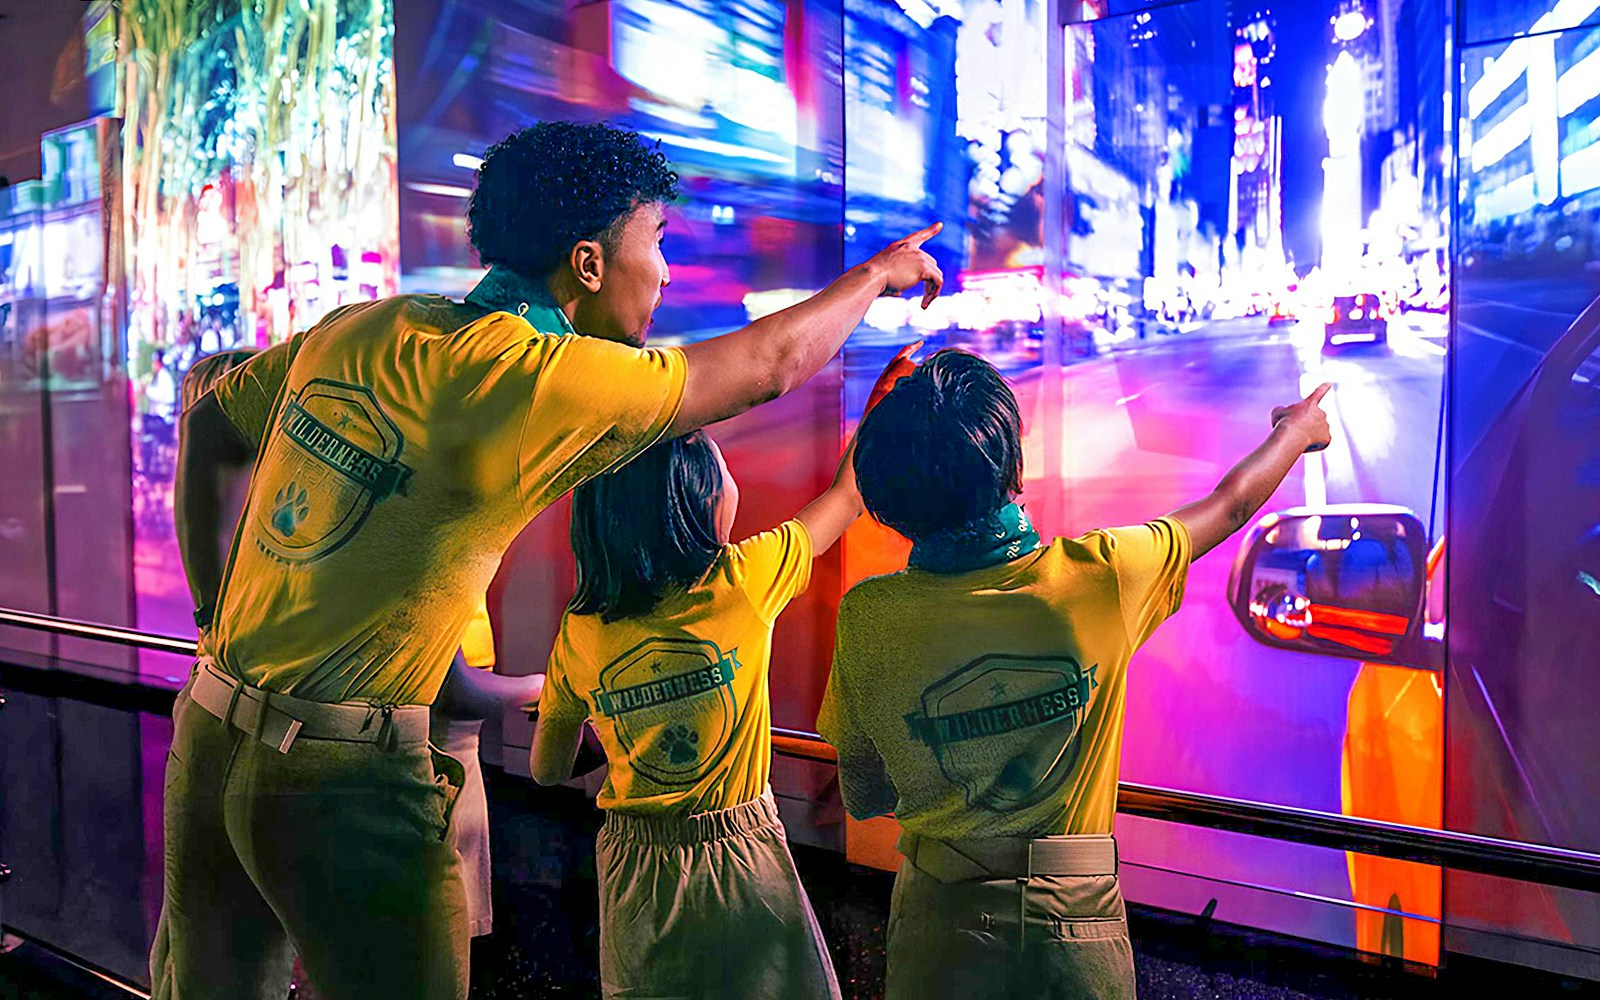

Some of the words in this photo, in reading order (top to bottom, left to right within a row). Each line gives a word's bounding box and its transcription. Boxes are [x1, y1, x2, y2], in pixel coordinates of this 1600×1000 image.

[283, 408, 383, 482] WILDERNESS
[609, 667, 723, 709] WILDERNESS
[937, 687, 1080, 741] WILDERNESS
